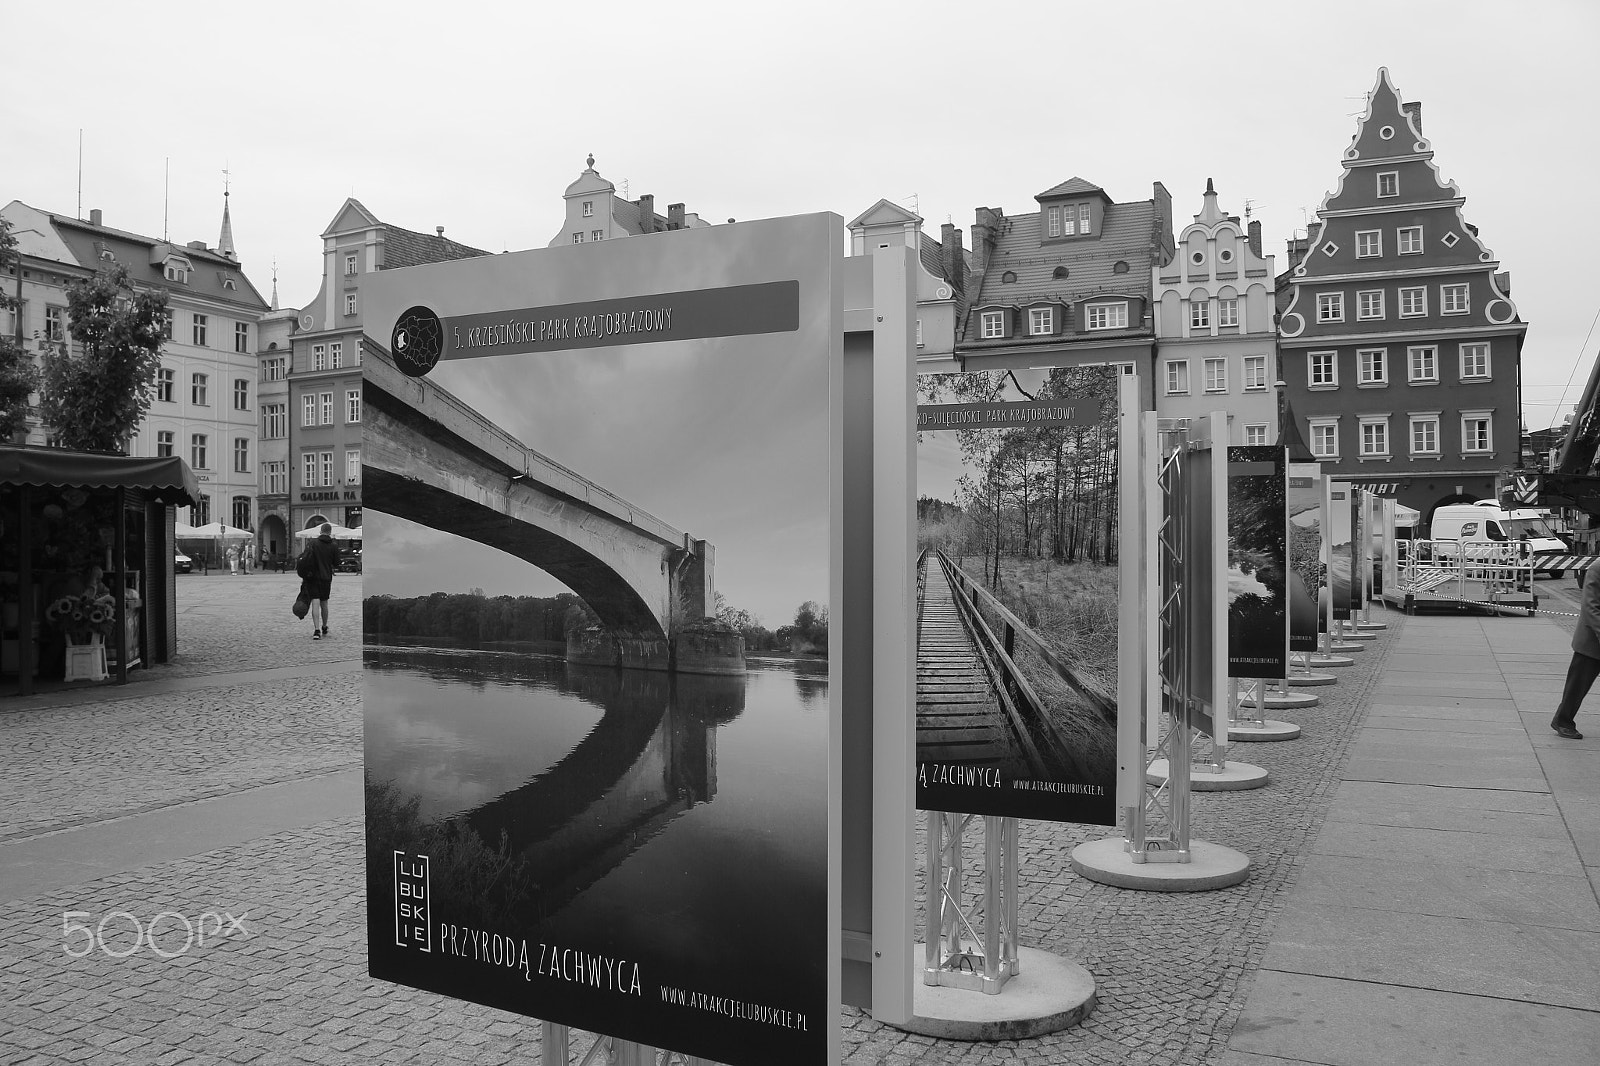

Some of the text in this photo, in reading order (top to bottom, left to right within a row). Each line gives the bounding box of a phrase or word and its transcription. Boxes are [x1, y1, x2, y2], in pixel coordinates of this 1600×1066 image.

[454, 307, 673, 350] 5. KRZESIŃSKI PARK KRAJOBRAZOWY
[986, 409, 1007, 422] PARK
[1010, 406, 1076, 423] KRAJOBRAZOWY
[300, 491, 340, 502] GALERIA
[932, 763, 1001, 789] ZACHWYCA
[1013, 779, 1104, 796] WWW.ATRAKCJELUBUSKIE.PL
[441, 923, 808, 1031] PRZYRODĄ ZACHWYCA WWW.ATRAKCJELUBUSKIE.PL
